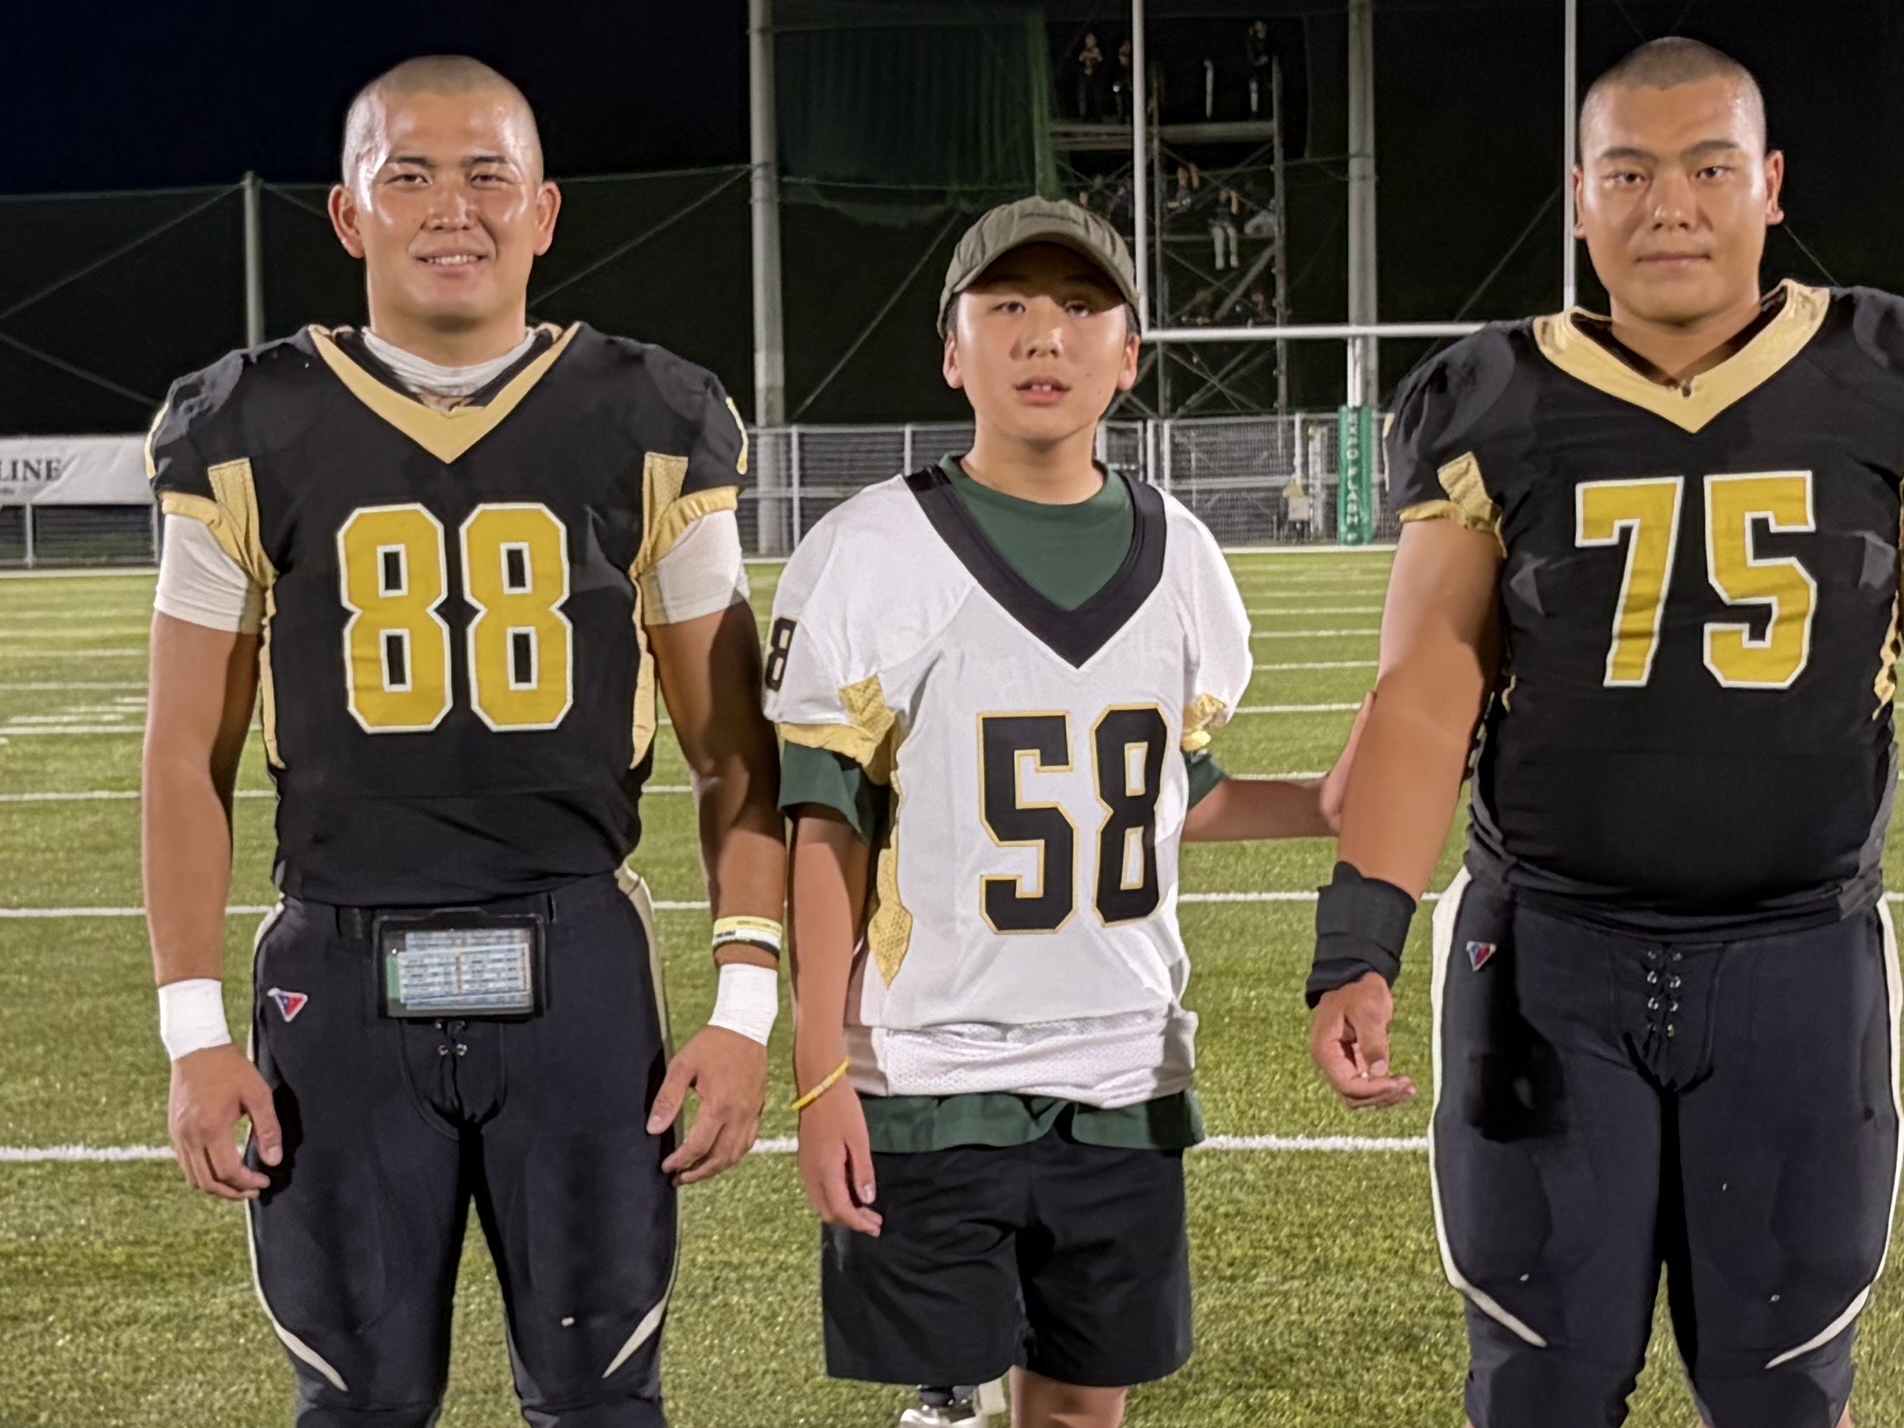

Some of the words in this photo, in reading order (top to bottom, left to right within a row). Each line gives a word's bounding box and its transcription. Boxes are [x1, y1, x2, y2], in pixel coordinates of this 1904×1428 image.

[337, 503, 574, 735] 88
[1574, 470, 1816, 690] 75
[976, 702, 1169, 935] 58
